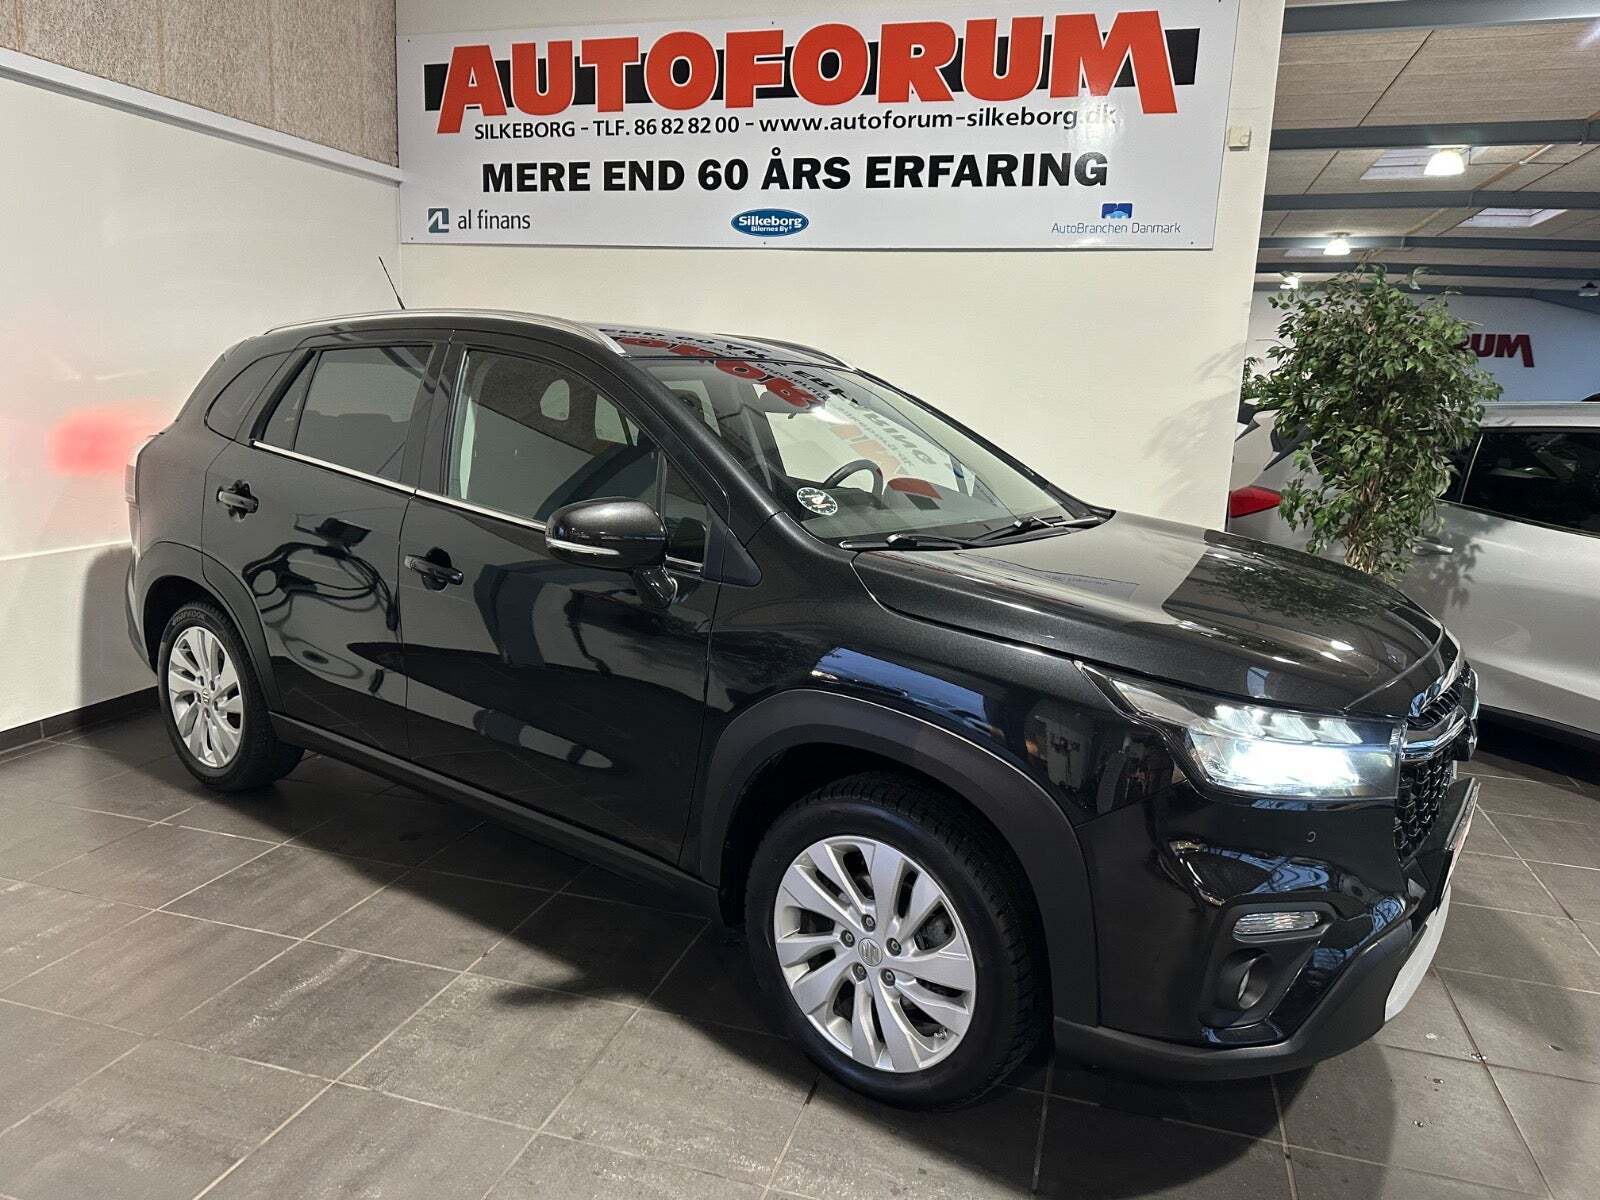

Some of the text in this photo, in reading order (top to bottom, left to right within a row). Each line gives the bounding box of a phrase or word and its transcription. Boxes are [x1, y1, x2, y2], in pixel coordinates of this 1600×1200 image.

[437, 10, 1178, 135] AUTOFORUM
[474, 121, 576, 140] SILKEBORG
[593, 120, 630, 138] TLF.
[482, 147, 1109, 193] MERE END 60 ÅRS ERFARING
[457, 209, 531, 230] al finans
[738, 215, 803, 229] Silkeborg
[1051, 222, 1182, 234] AutoBranchen Danmark
